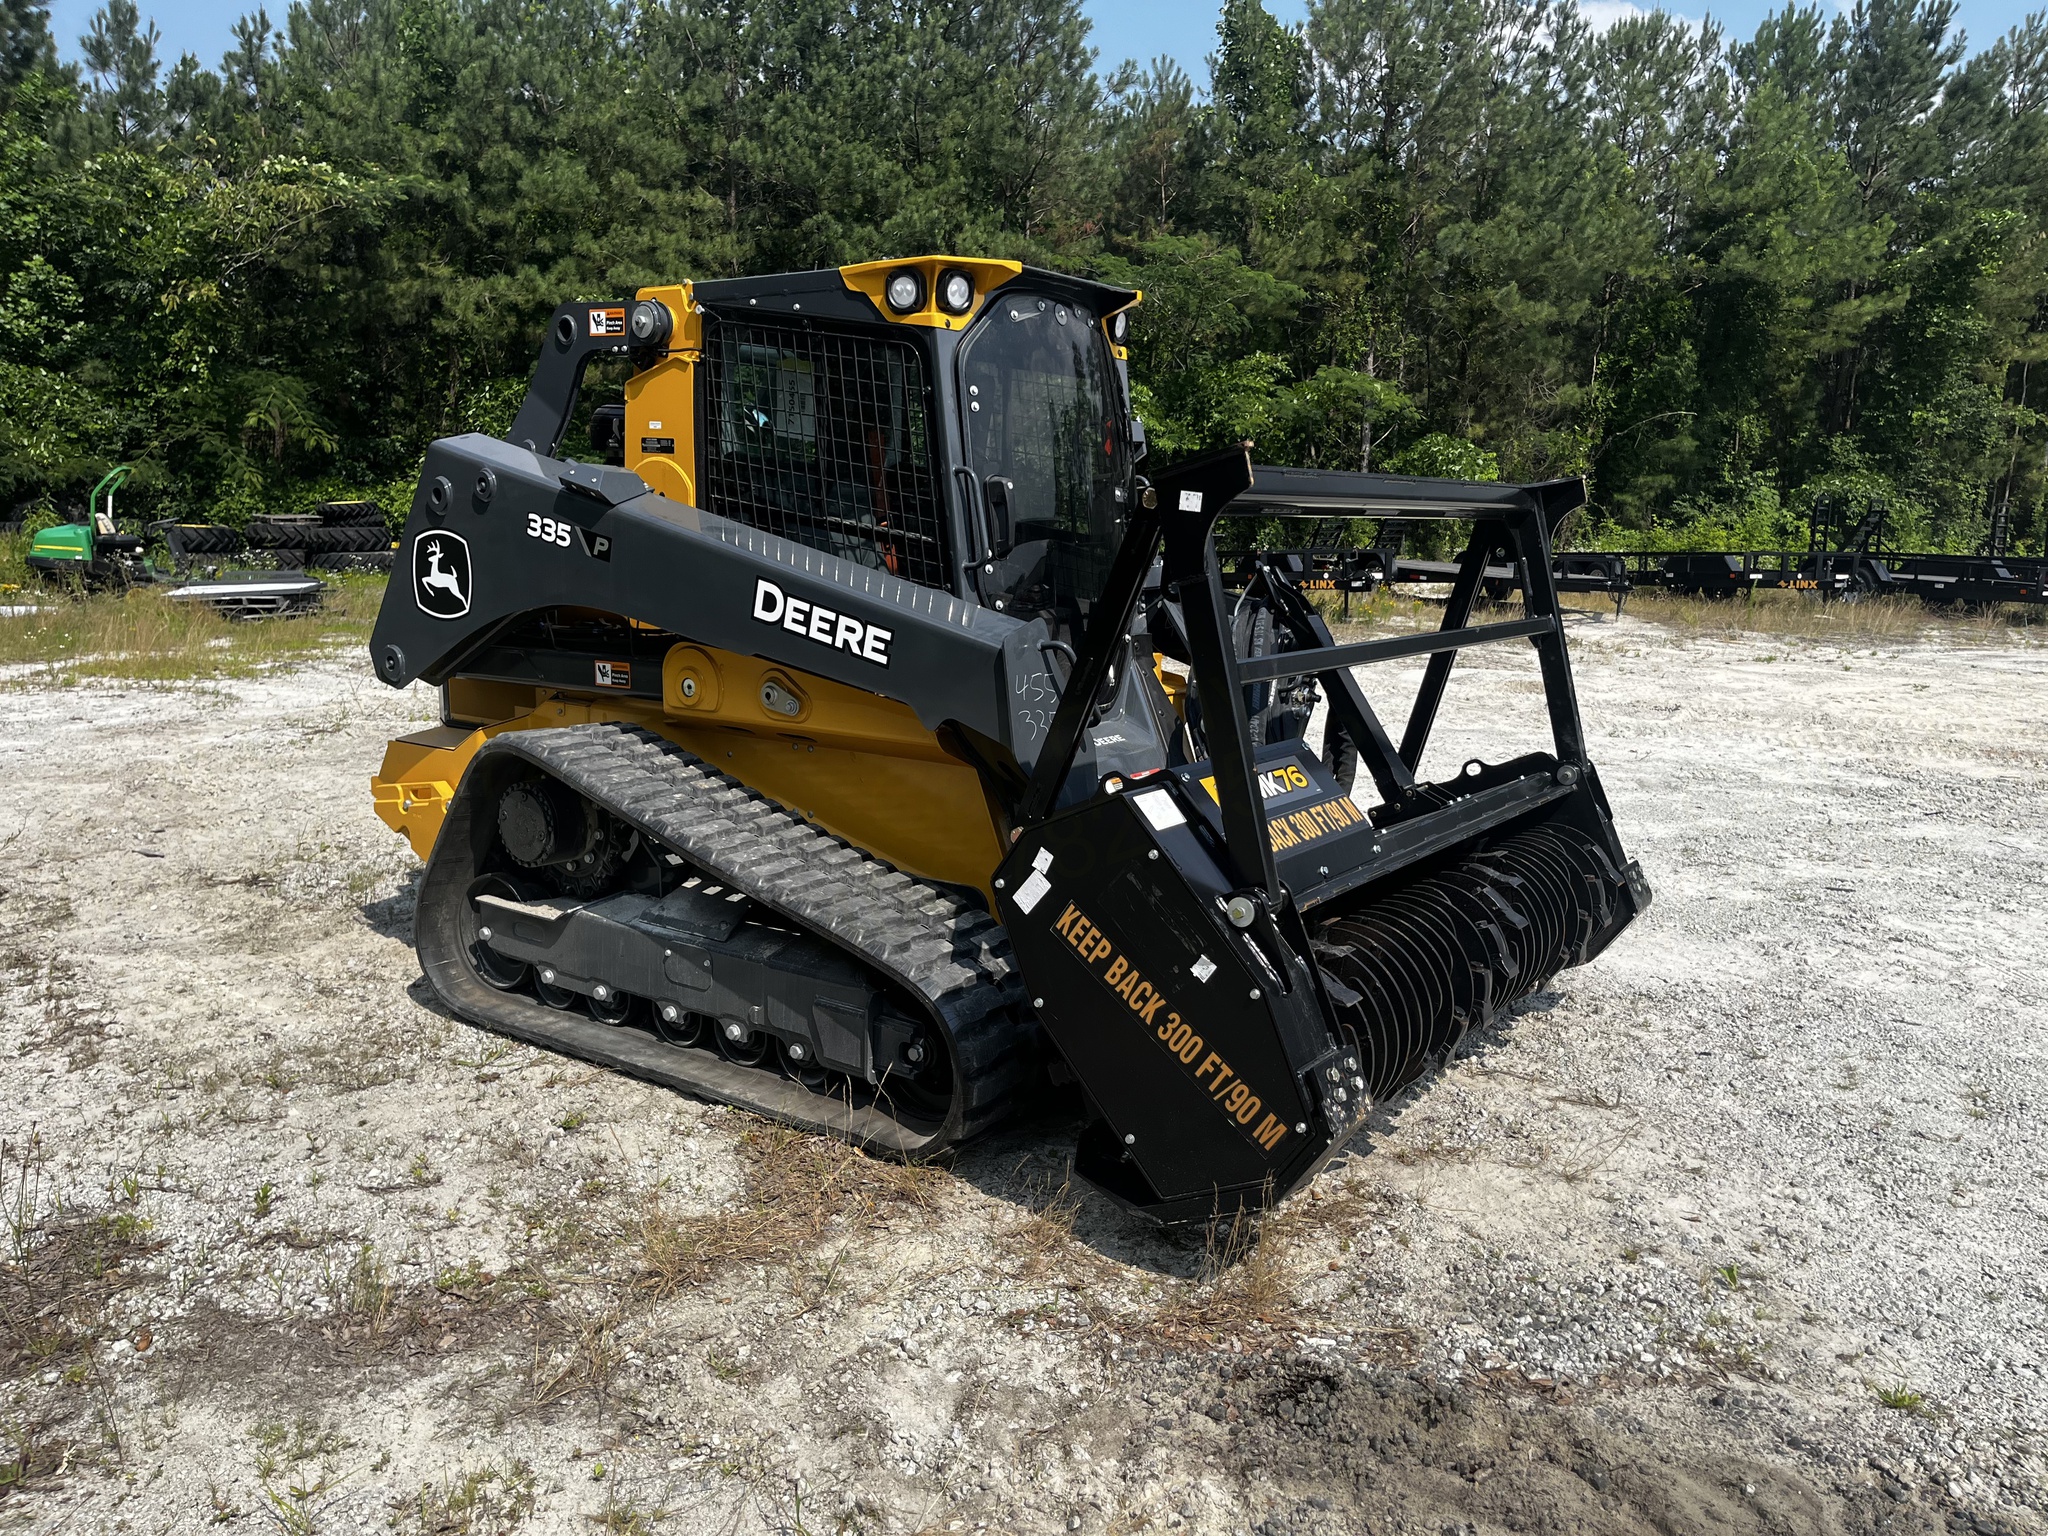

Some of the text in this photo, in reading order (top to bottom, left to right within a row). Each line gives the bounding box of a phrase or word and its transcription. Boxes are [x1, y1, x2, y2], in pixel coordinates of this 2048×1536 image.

[526, 512, 609, 556] 335 P
[1310, 579, 1336, 589] LINX
[1789, 579, 1819, 589] LINX
[753, 579, 892, 665] DEERE
[1015, 672, 1058, 704] 455
[1290, 810, 1323, 841] 300
[1308, 800, 1352, 832] FT/90
[1338, 796, 1364, 822] M
[1055, 903, 1112, 964] KEEP
[1103, 954, 1167, 1026] BACK
[1157, 1012, 1204, 1064] 300
[1194, 1051, 1262, 1125] FT/90
[1252, 1112, 1288, 1152] M
